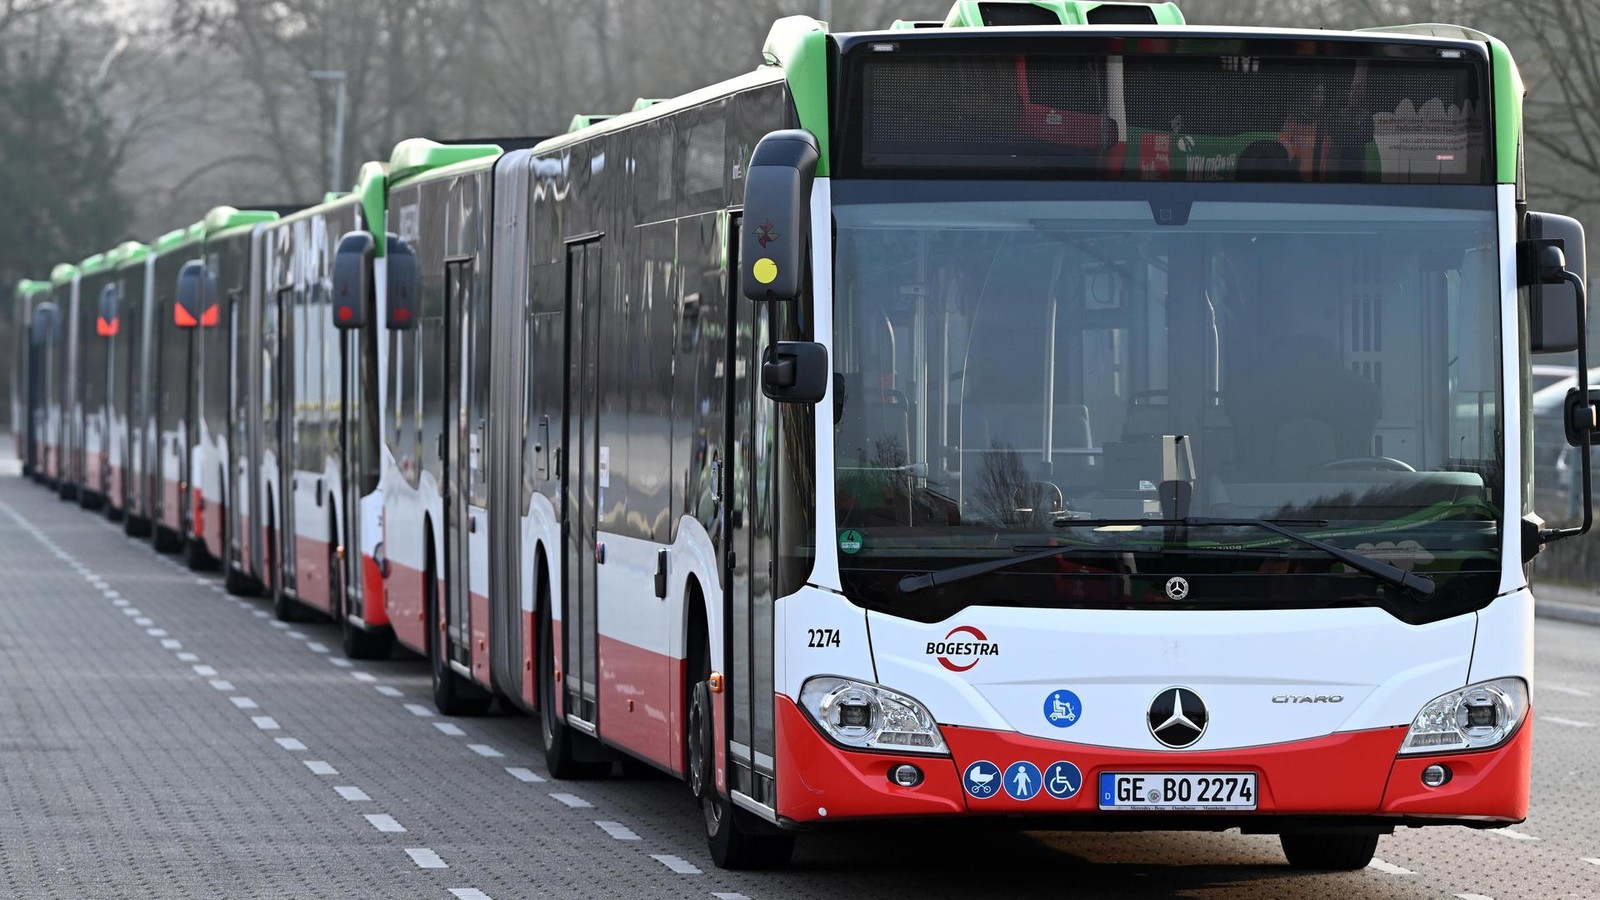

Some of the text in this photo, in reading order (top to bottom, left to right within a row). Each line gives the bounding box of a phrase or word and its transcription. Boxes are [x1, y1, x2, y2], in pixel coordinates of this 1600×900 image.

[847, 530, 855, 542] 4
[807, 629, 841, 648] 2274
[925, 642, 999, 656] BOGESTRA
[1271, 694, 1344, 704] CITARO
[1104, 792, 1111, 800] D
[1117, 777, 1252, 802] GE BO 2274
